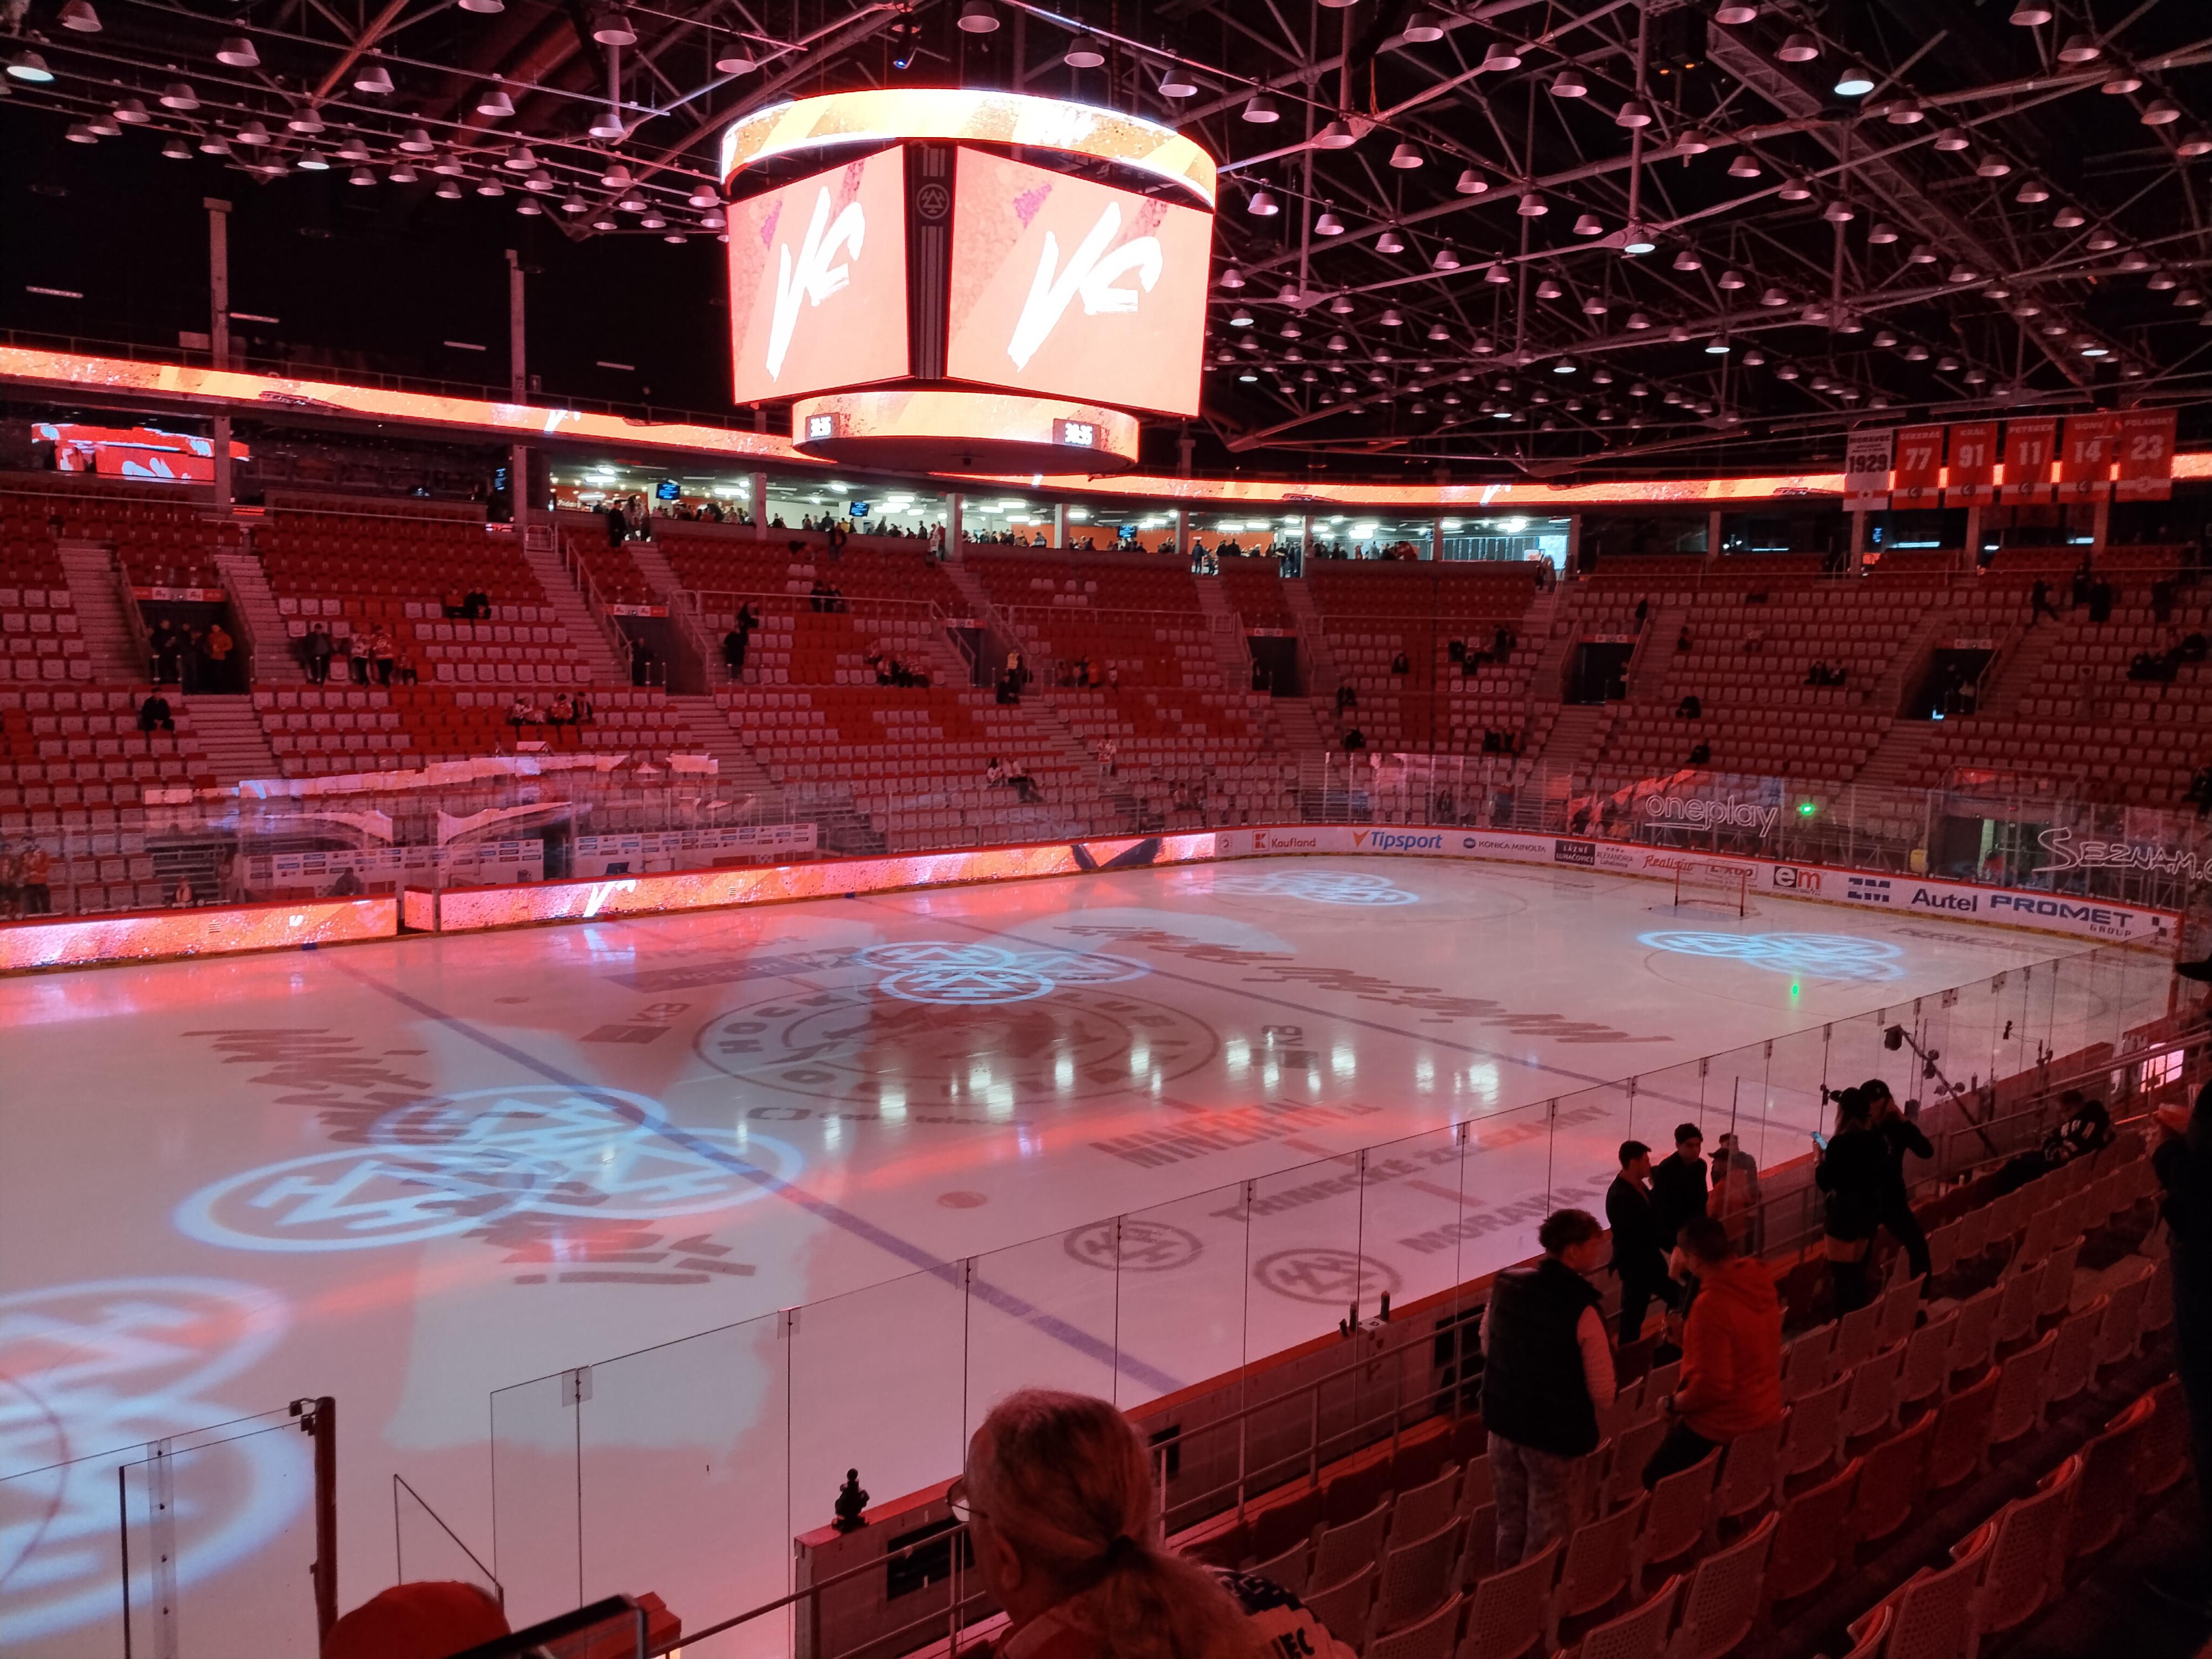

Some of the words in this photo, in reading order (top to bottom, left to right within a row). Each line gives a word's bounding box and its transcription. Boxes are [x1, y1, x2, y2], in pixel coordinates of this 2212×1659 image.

[1905, 447, 1933, 470] 77
[1958, 444, 1984, 468] 91
[2020, 441, 2041, 465] 11
[2074, 440, 2102, 464] 14
[2131, 434, 2164, 460] 23
[1849, 453, 1888, 473] 1929
[1645, 795, 1778, 837] oneplay
[1271, 837, 1316, 848] Kaufland
[1371, 831, 1443, 851] Tipsport
[1478, 841, 1509, 849] KONICA
[1510, 843, 1546, 853] MINOLTA
[1775, 867, 1821, 890] em
[1911, 888, 1978, 912] Autel
[1990, 894, 2133, 927] PROMET
[2089, 924, 2132, 937] GROUP
